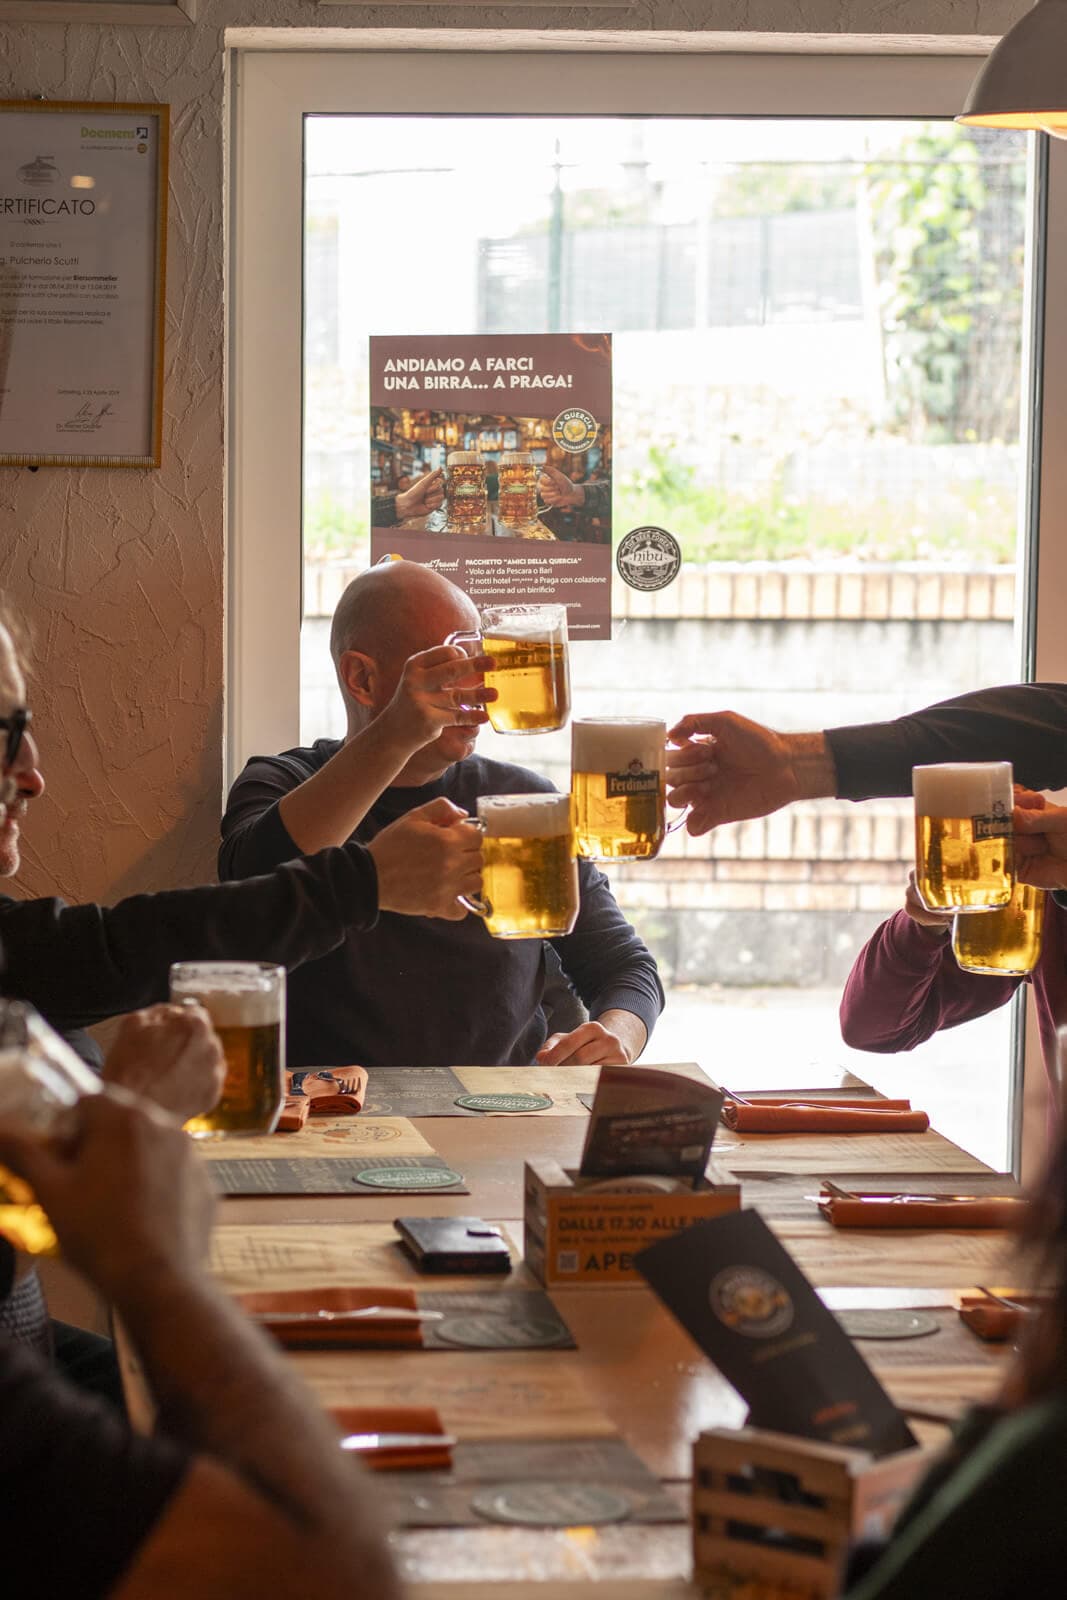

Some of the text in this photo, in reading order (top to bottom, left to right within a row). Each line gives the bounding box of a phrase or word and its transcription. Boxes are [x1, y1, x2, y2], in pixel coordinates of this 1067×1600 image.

[383, 356, 534, 373] ANDIAMO A FARCI
[383, 374, 574, 391] UNA BIRRA... A PRAGA!
[556, 411, 593, 430] LA QUERCIA
[469, 567, 484, 575] Volo
[493, 576, 511, 584] hotel
[539, 577, 559, 585] Praga
[574, 575, 607, 583] colazione
[469, 586, 505, 595] Escursione
[506, 586, 515, 594] ad
[558, 1217, 605, 1231] DALLE
